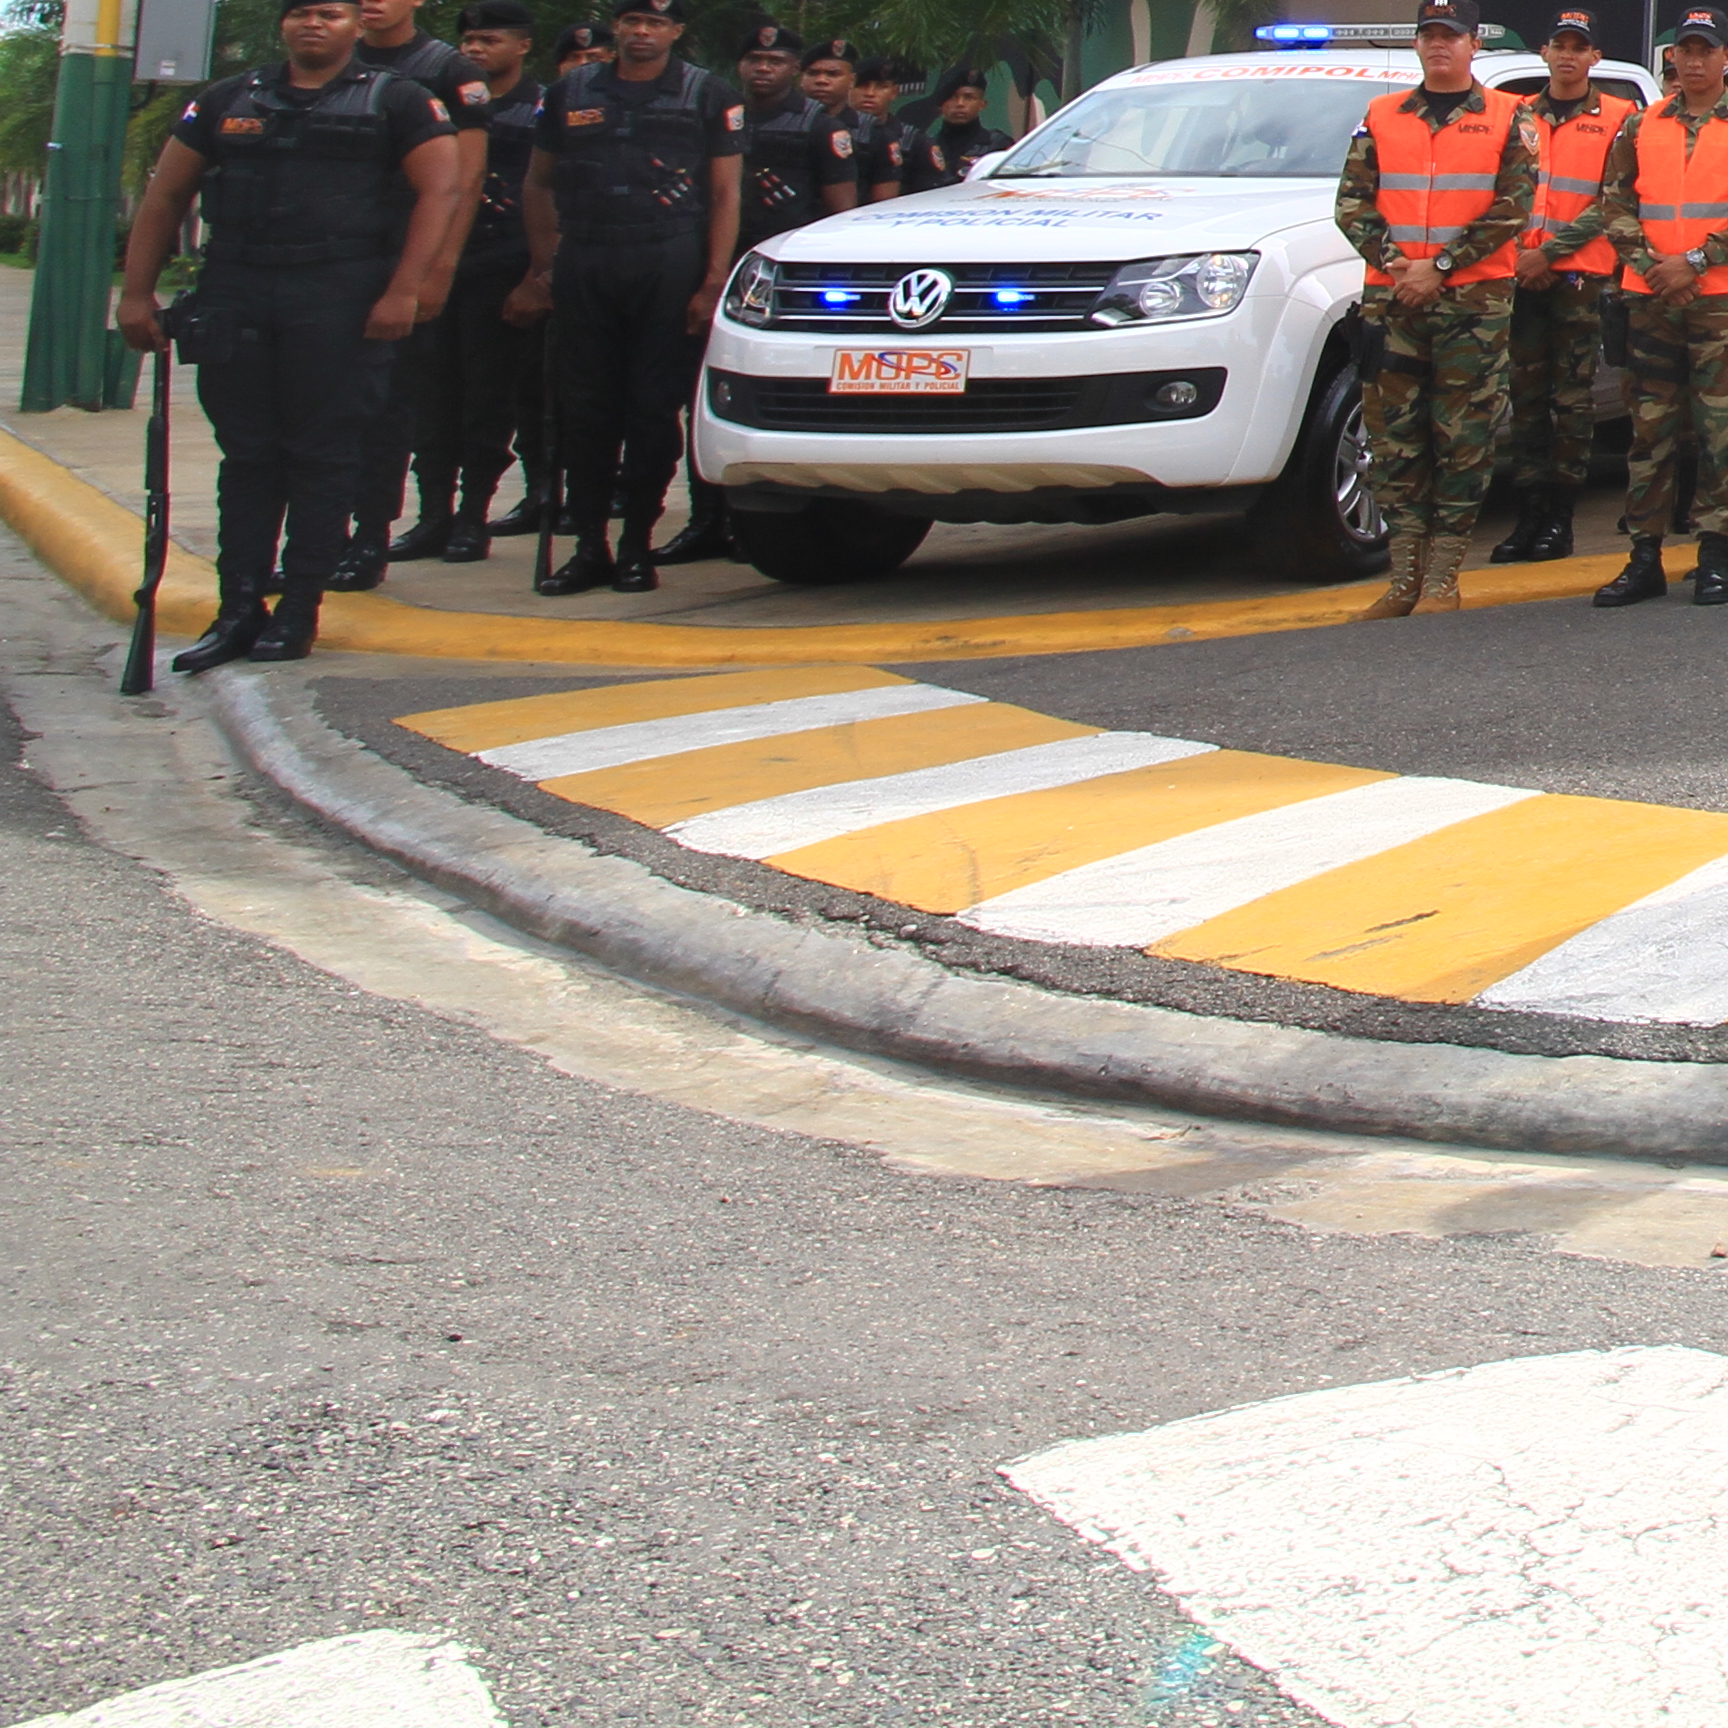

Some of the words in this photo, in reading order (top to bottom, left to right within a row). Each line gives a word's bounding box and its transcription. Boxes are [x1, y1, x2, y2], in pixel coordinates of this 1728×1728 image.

[1193, 66, 1377, 80] COMIPOL
[853, 209, 1022, 222] COMISION
[1028, 209, 1164, 221] MILITAR
[915, 218, 1069, 228] POLICIAL
[838, 351, 964, 381] MOPC
[836, 381, 875, 390] COMISION
[879, 381, 911, 390] MILITAR
[915, 381, 920, 390] Y
[924, 381, 960, 390] POLICIAL
